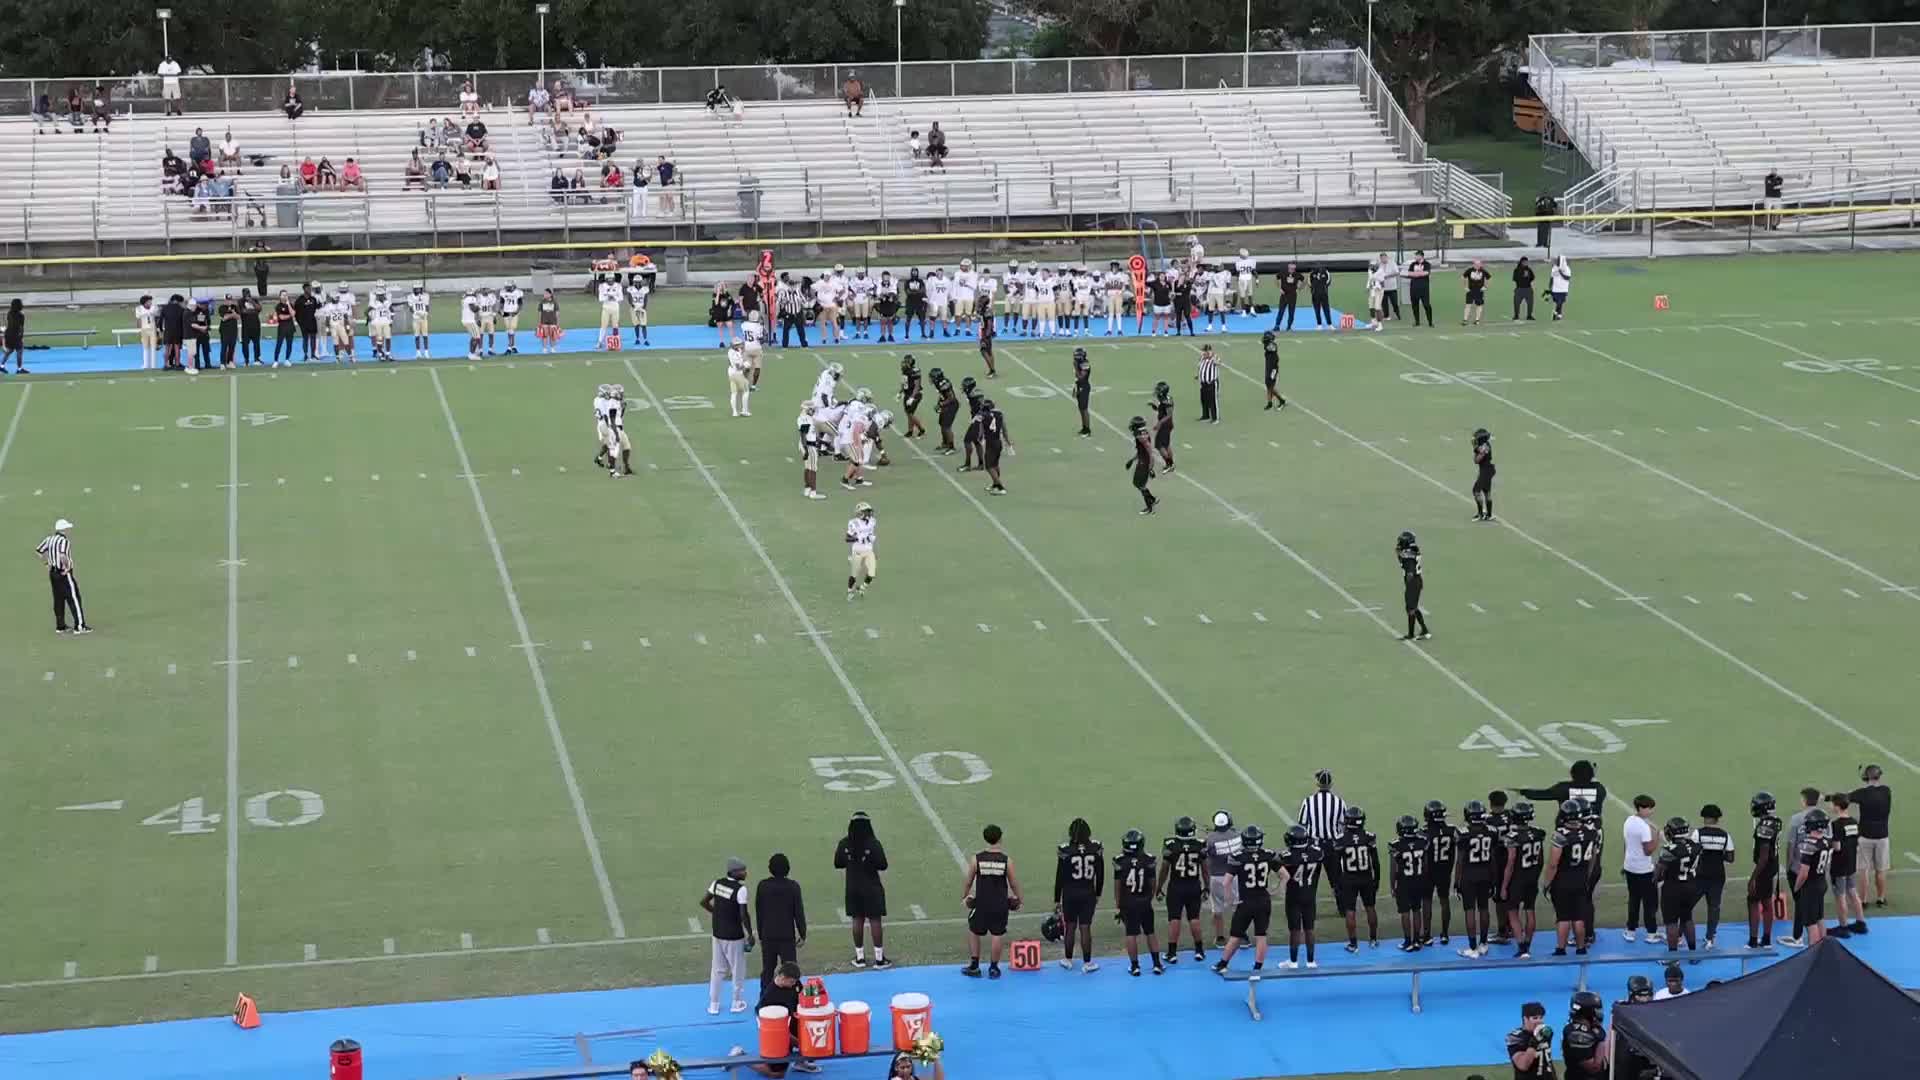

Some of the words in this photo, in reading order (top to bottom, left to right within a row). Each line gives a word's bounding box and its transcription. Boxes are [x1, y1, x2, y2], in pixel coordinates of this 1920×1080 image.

[762, 251, 773, 269] 2
[1341, 316, 1355, 328] 30
[607, 337, 619, 348] 50
[989, 416, 997, 433] 4
[1457, 721, 1628, 758] 40
[809, 750, 993, 792] 50
[137, 788, 324, 835] 40
[1345, 846, 1369, 872] 20
[1432, 836, 1451, 862] 12
[1469, 836, 1491, 863] 28
[1071, 854, 1096, 880] 36
[1175, 852, 1200, 878] 45
[1243, 861, 1269, 889] 33
[1294, 862, 1318, 887] 47
[1402, 850, 1424, 876] 37
[1126, 867, 1145, 893] 41
[1013, 944, 1039, 969] 50
